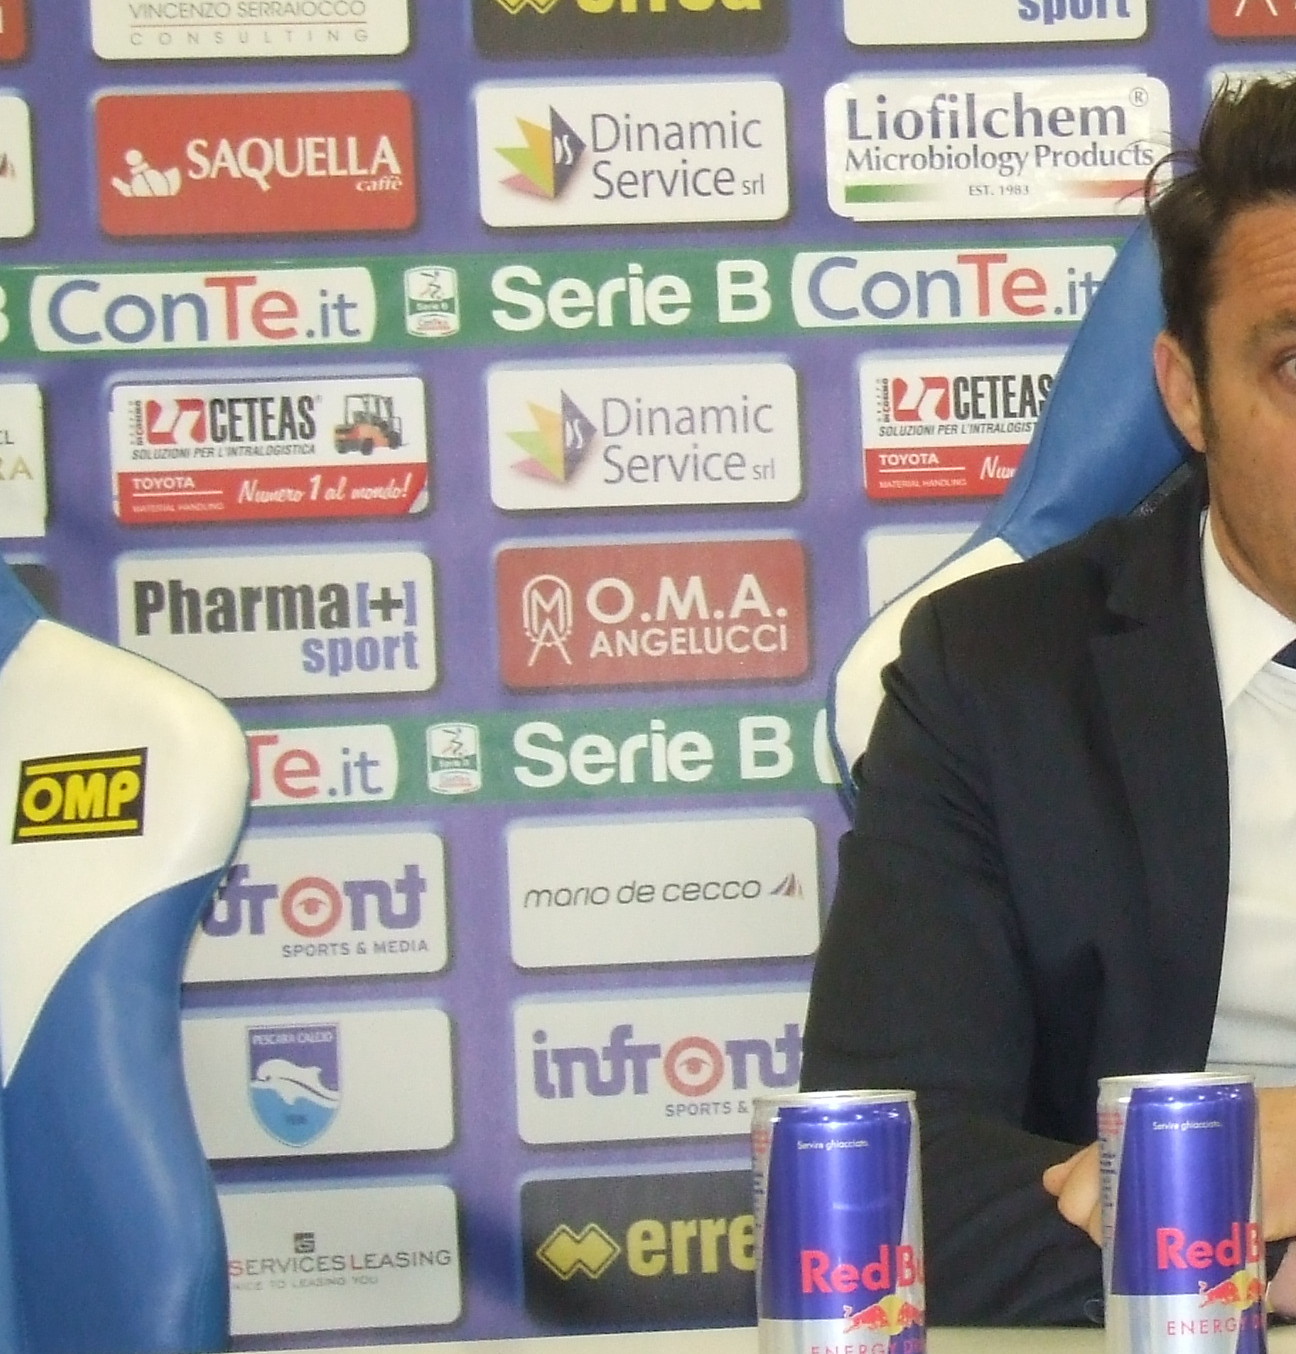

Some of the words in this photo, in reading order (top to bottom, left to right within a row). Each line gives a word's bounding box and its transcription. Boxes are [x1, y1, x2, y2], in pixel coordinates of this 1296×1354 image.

[129, 2, 231, 19] VINCENZO
[237, 0, 366, 18] SERRAIOCCO
[130, 29, 368, 46] CONSULTING
[591, 110, 763, 154] Dinamic
[847, 92, 1127, 142] Liofilchem
[186, 136, 402, 192] SAQUELLA
[593, 160, 735, 201] Service
[743, 174, 766, 196] srl
[845, 144, 1029, 177] Microbiology
[1035, 143, 1154, 169] Products
[969, 184, 994, 197] EST.
[1000, 184, 1029, 197] 1983
[48, 276, 363, 345] ConTe.it
[491, 262, 693, 332] Serie
[717, 259, 772, 324] B
[209, 394, 317, 444] CETEAS
[602, 394, 774, 438] Dinamic
[938, 425, 958, 435] PER
[193, 446, 216, 458] PER
[604, 444, 746, 484] Service
[752, 458, 776, 480] srl
[879, 452, 940, 466] TOYOTA
[132, 477, 195, 490] TOYOTA
[238, 479, 306, 505] Numero
[310, 474, 322, 501] 1
[586, 574, 788, 624] O.M.A.
[302, 634, 419, 676] sport
[590, 625, 788, 658] ANGELUCCI
[247, 734, 384, 801] Te.it
[513, 719, 714, 788] Serie
[739, 715, 794, 780] B
[22, 770, 141, 823] OMP
[523, 887, 610, 909] mario
[616, 880, 655, 904] de
[662, 879, 762, 902] cecco
[281, 942, 351, 958] SPORTS
[356, 941, 367, 955] &
[373, 939, 428, 954] MEDIA
[532, 1023, 803, 1100] infront
[665, 1102, 733, 1118] SPORTS
[228, 1255, 346, 1277] SERVICES
[350, 1250, 452, 1271] LEASING
[626, 1215, 757, 1277] erre
[1156, 1222, 1241, 1270] Red
[801, 1243, 890, 1294] Red
